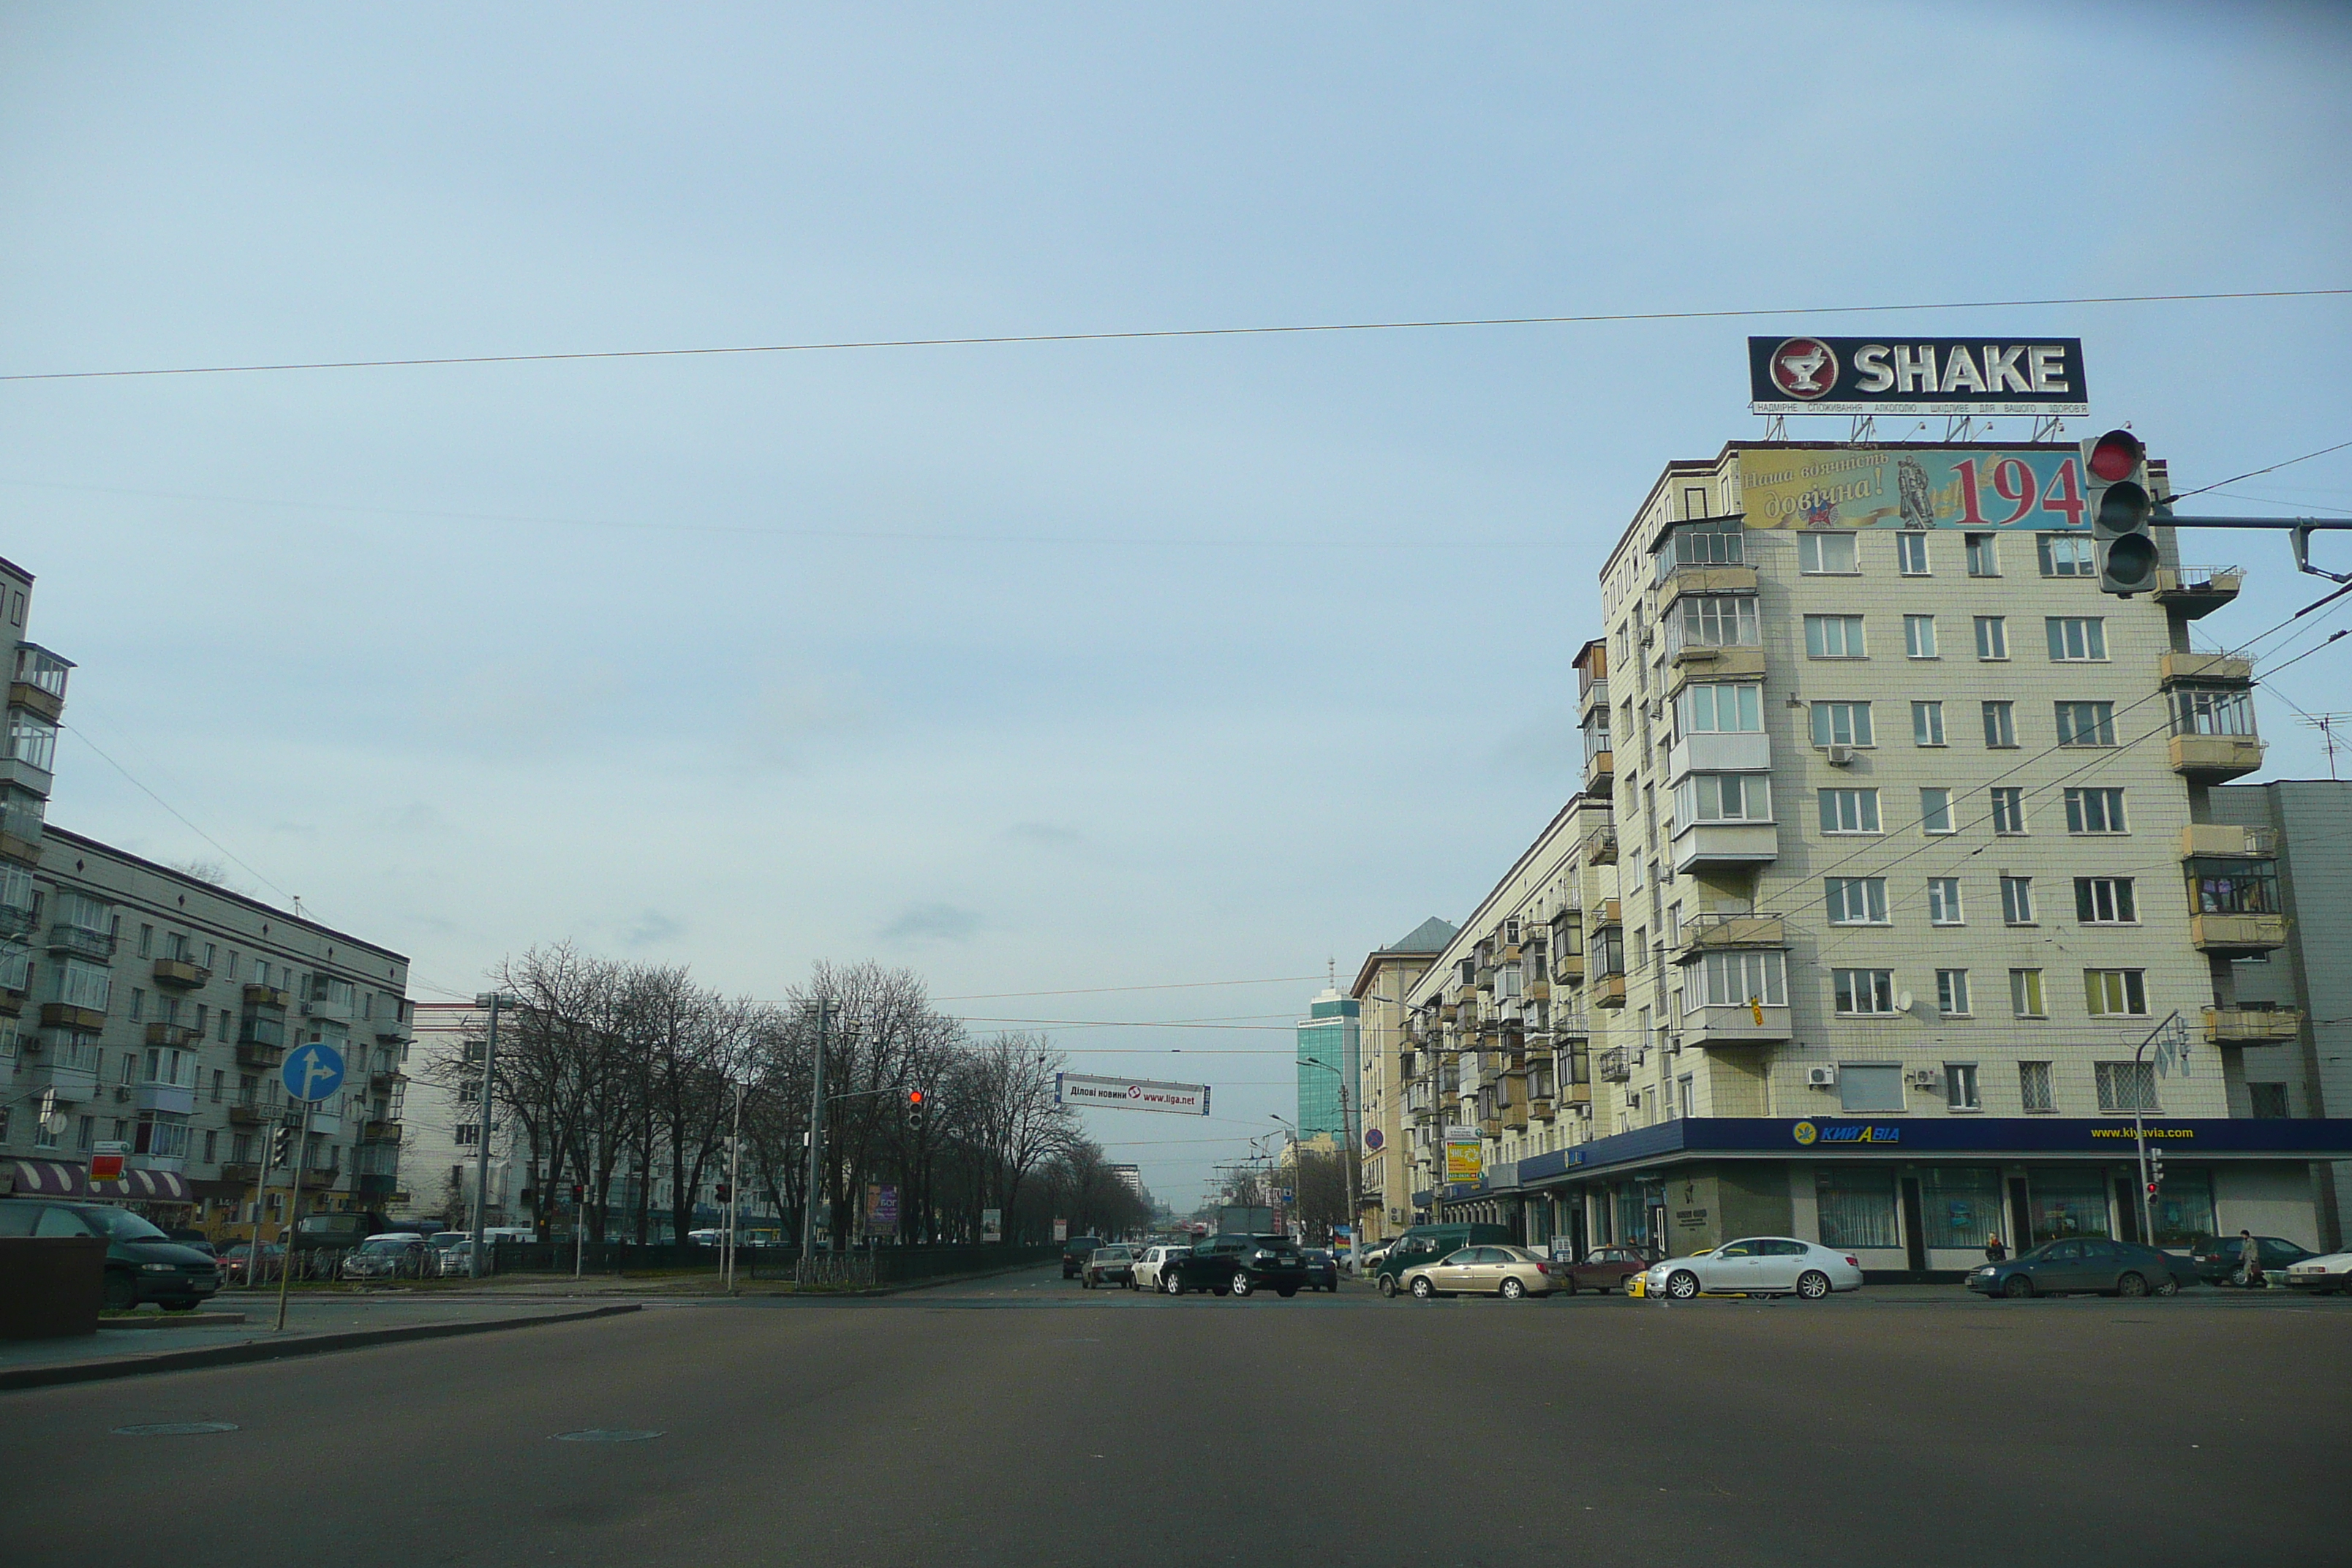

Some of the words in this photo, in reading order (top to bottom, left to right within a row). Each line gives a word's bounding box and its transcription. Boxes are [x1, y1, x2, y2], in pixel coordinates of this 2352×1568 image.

[1854, 344, 2069, 393] SHAKE
[1757, 403, 1798, 412] НАДМІРНЕ
[1807, 403, 1863, 412] СПОЖИВАННЯ
[1874, 404, 1917, 412] АЛКОГОЛЮ
[1930, 404, 1970, 413] ШКІДЛИВЕ
[1979, 404, 1996, 413] ДЛЯ
[2005, 404, 2037, 413] ВАШОГО
[1743, 470, 1794, 489] Наша
[1801, 453, 1890, 479] вдячність
[1949, 457, 2086, 525] 194
[1070, 1086, 1096, 1097] Ділові
[1098, 1090, 1127, 1099] новини
[1143, 1093, 1195, 1105] www.liga.net
[2091, 1127, 2194, 1139] www.kiyavia.com
